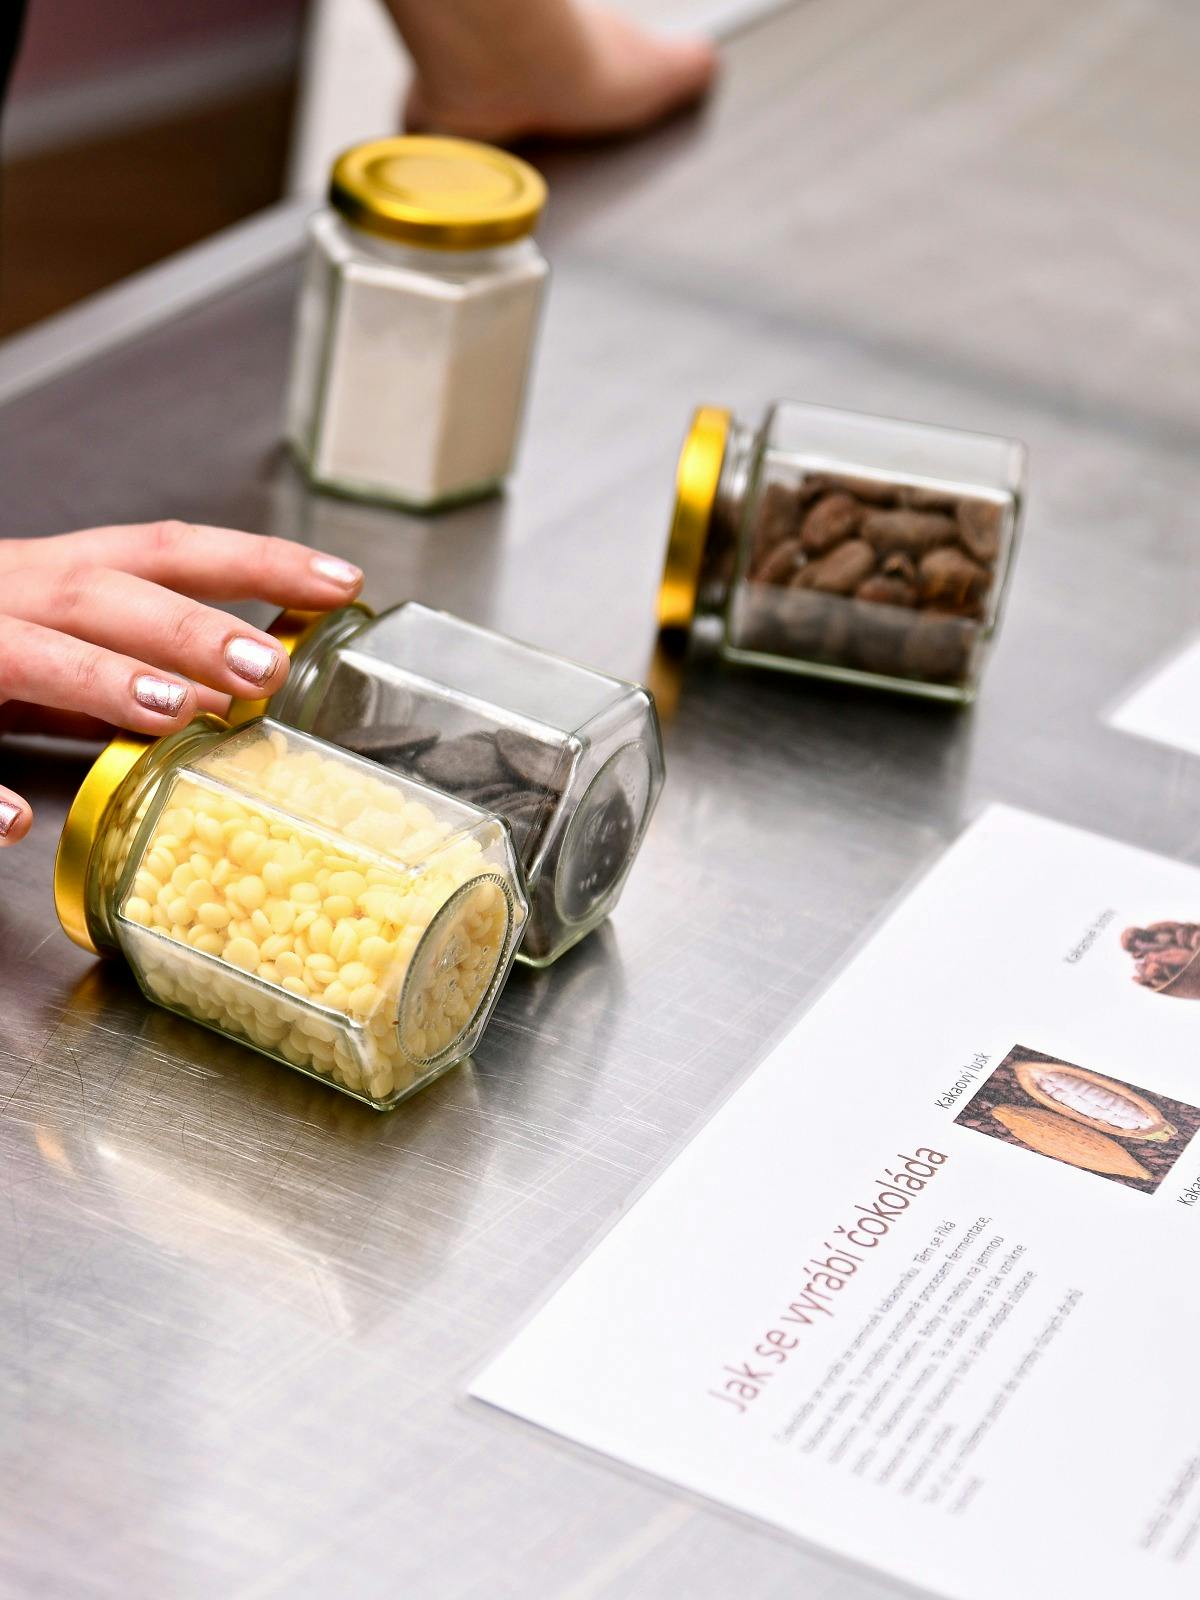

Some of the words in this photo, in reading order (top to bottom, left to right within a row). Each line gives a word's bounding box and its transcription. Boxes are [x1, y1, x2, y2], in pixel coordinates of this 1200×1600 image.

[934, 1069, 979, 1109] Kakaový
[963, 1052, 992, 1072] lusk
[710, 1363, 772, 1412] Jak
[755, 1330, 799, 1363] se
[781, 1242, 864, 1324] vyrábí
[834, 1148, 948, 1247] čokoláda
[918, 1261, 955, 1302] procesem
[944, 1216, 993, 1260] fermentace,
[966, 1266, 982, 1279] na
[975, 1235, 1005, 1269] jemnou
[985, 1275, 1004, 1290] tak
[998, 1244, 1028, 1275] vznikne
